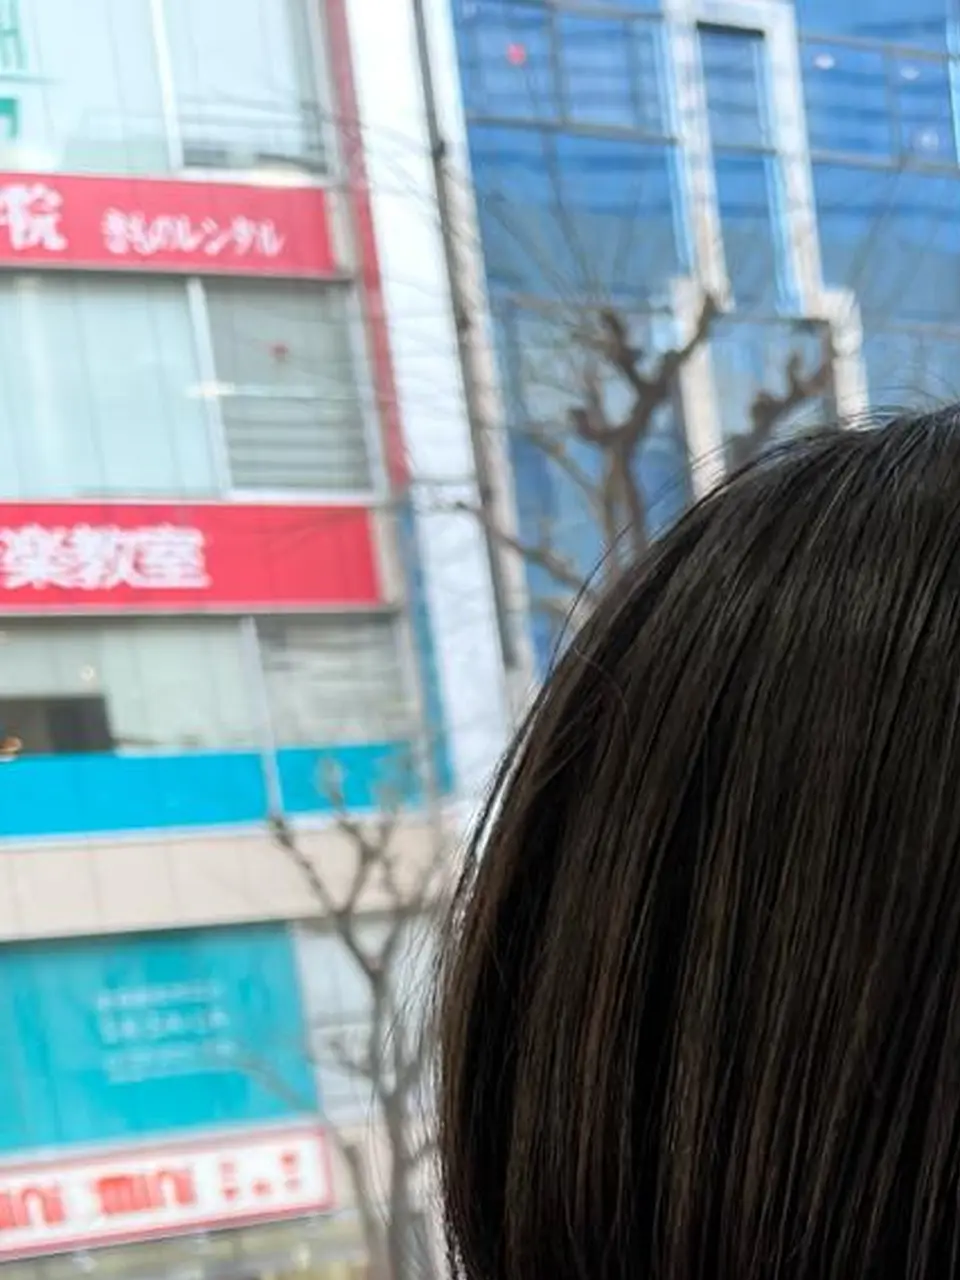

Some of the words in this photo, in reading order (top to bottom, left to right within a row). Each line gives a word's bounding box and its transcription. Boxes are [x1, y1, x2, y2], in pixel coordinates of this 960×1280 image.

[0, 184, 68, 251] 院
[101, 207, 286, 256] きものレンタル
